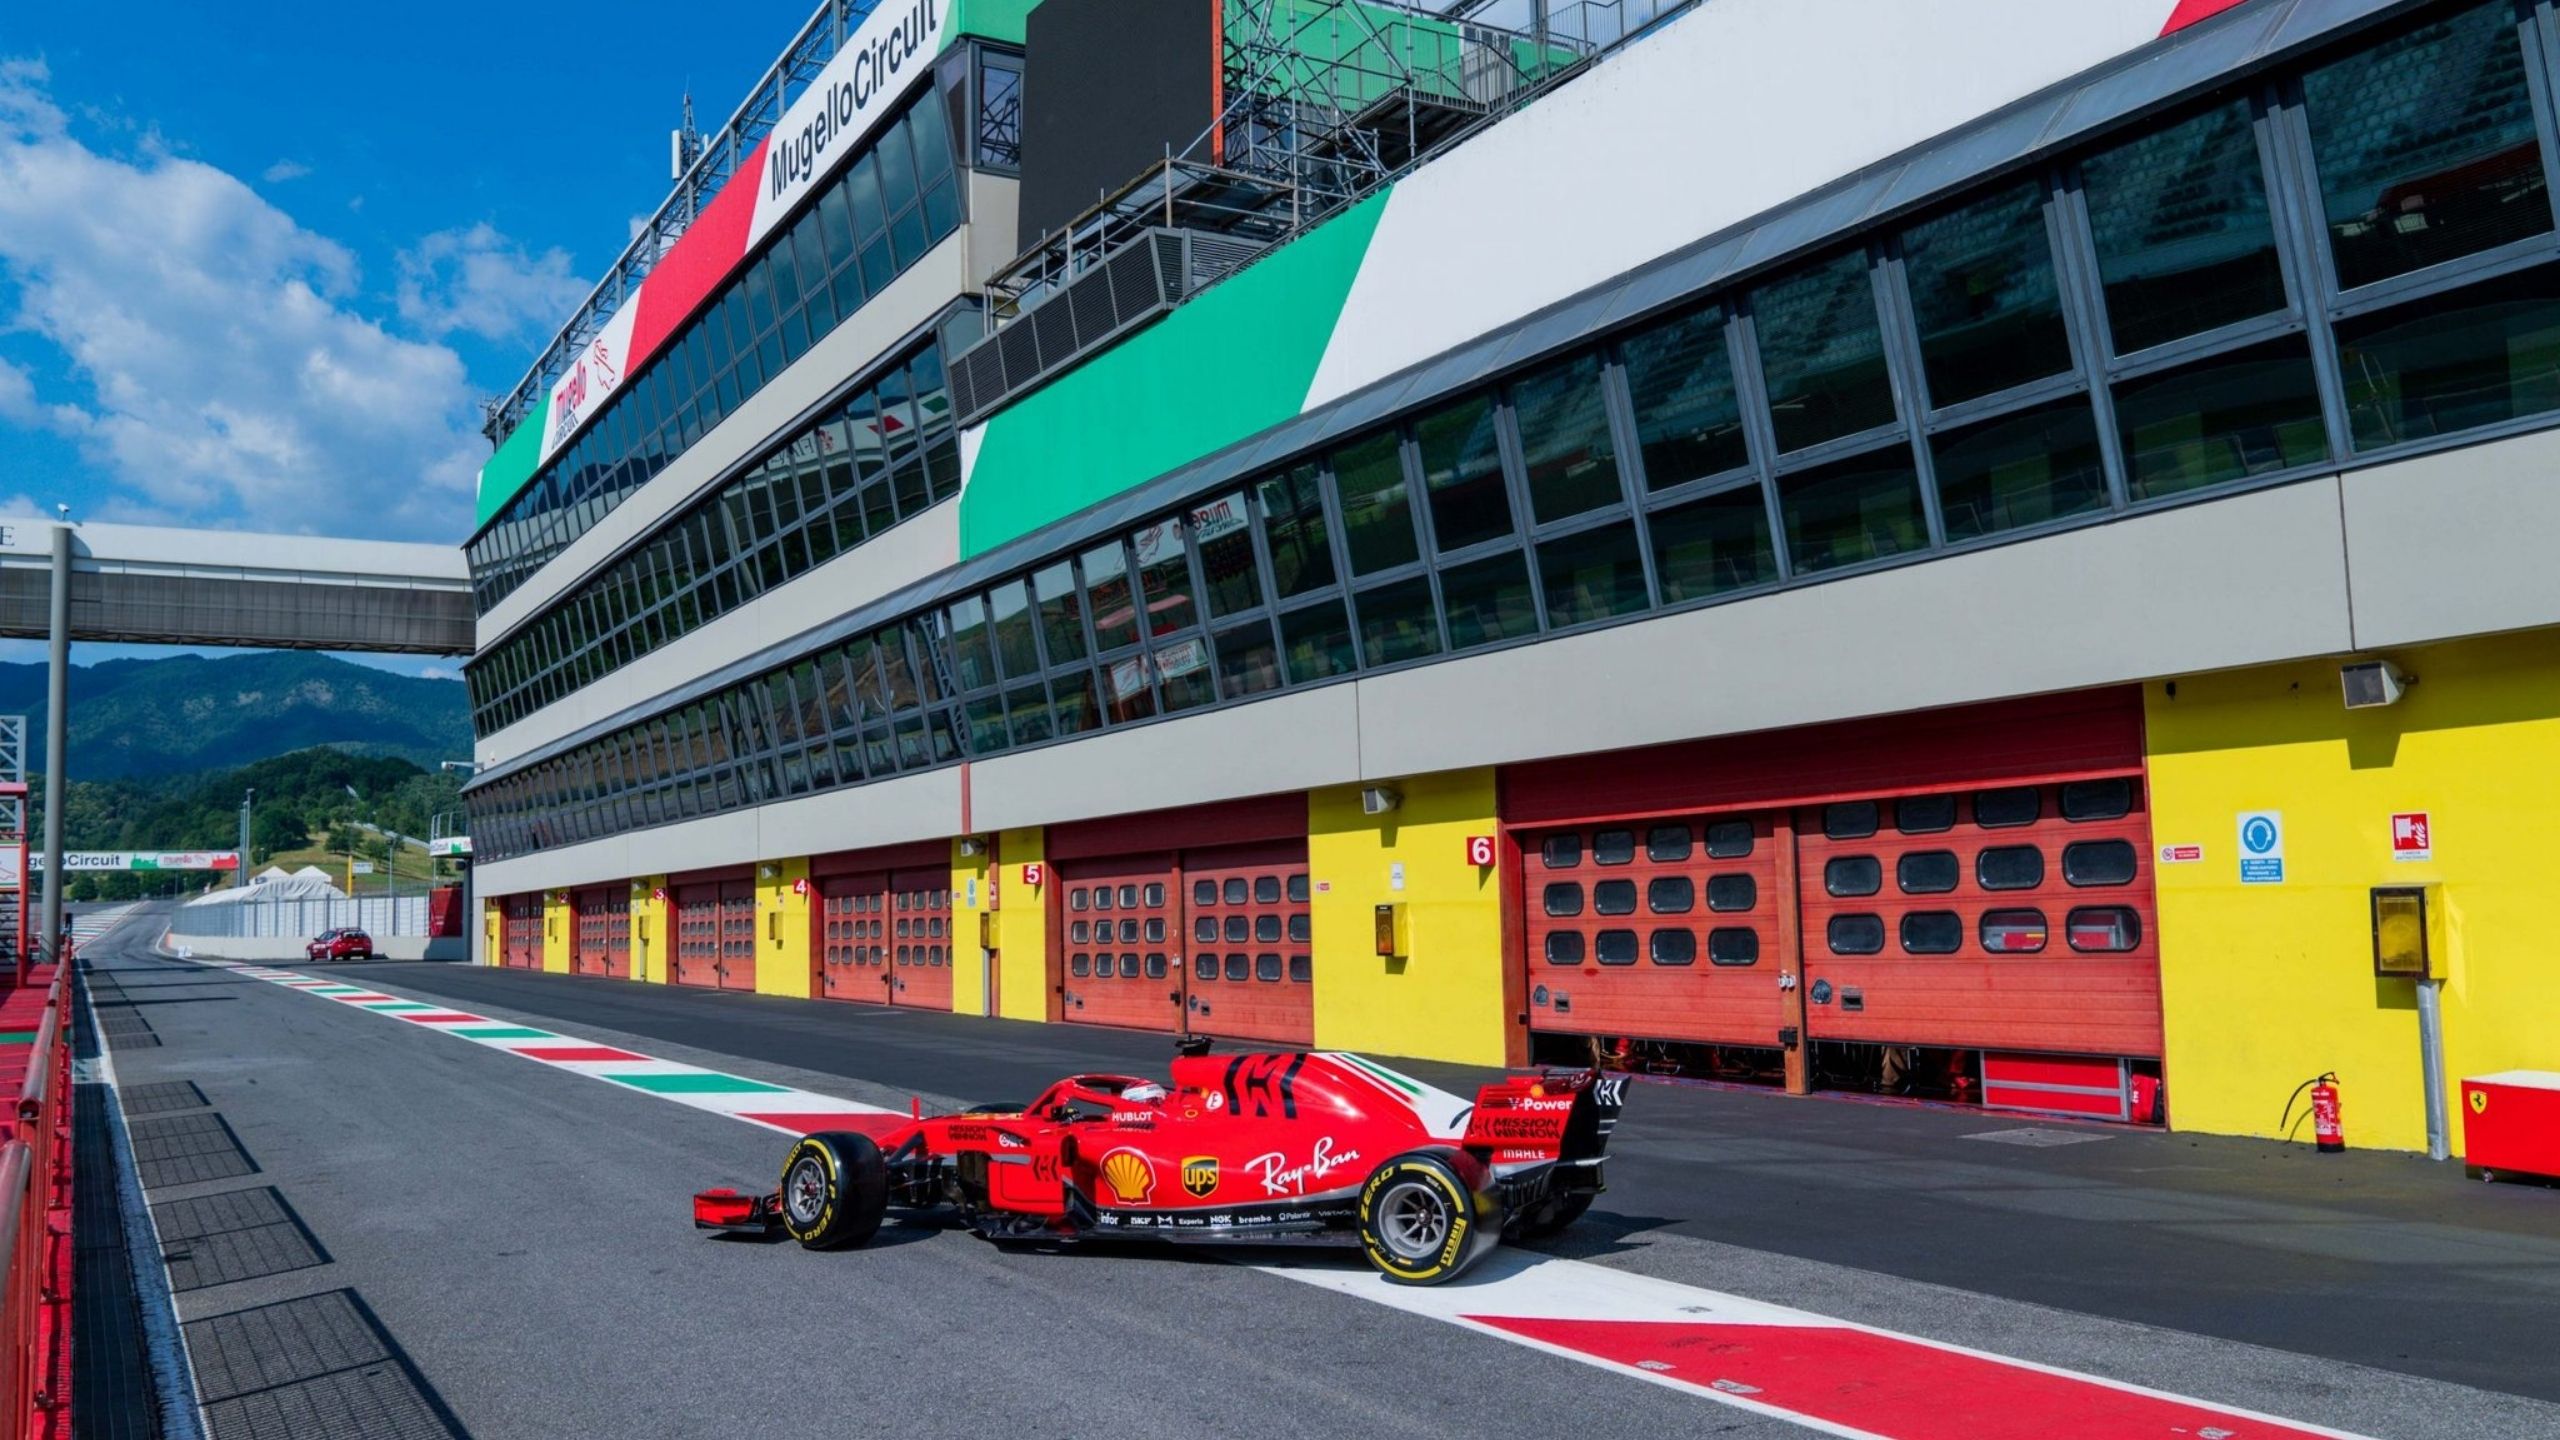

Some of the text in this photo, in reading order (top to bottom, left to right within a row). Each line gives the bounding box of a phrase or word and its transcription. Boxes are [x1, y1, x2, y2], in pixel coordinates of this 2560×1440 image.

[772, 0, 937, 202] MugelloCircuit
[1472, 837, 1491, 864] 6
[1027, 865, 1040, 884] 5
[795, 879, 807, 894] 4
[654, 888, 665, 900] 3
[1508, 1097, 1574, 1111] V-Power
[1112, 1111, 1153, 1122] HUBLOT
[1493, 1117, 1559, 1128] MISSION
[1494, 1127, 1561, 1139] WINNOW
[1502, 1149, 1546, 1159] MAHLE
[1184, 1168, 1217, 1192] ups
[1360, 1166, 1395, 1222] ZERO
[804, 1203, 833, 1240] ZERO
[1100, 1212, 1119, 1225] infor
[1210, 1215, 1232, 1224] NGK
[1238, 1214, 1272, 1224] brembo
[1440, 1217, 1468, 1267] PIRELLI
